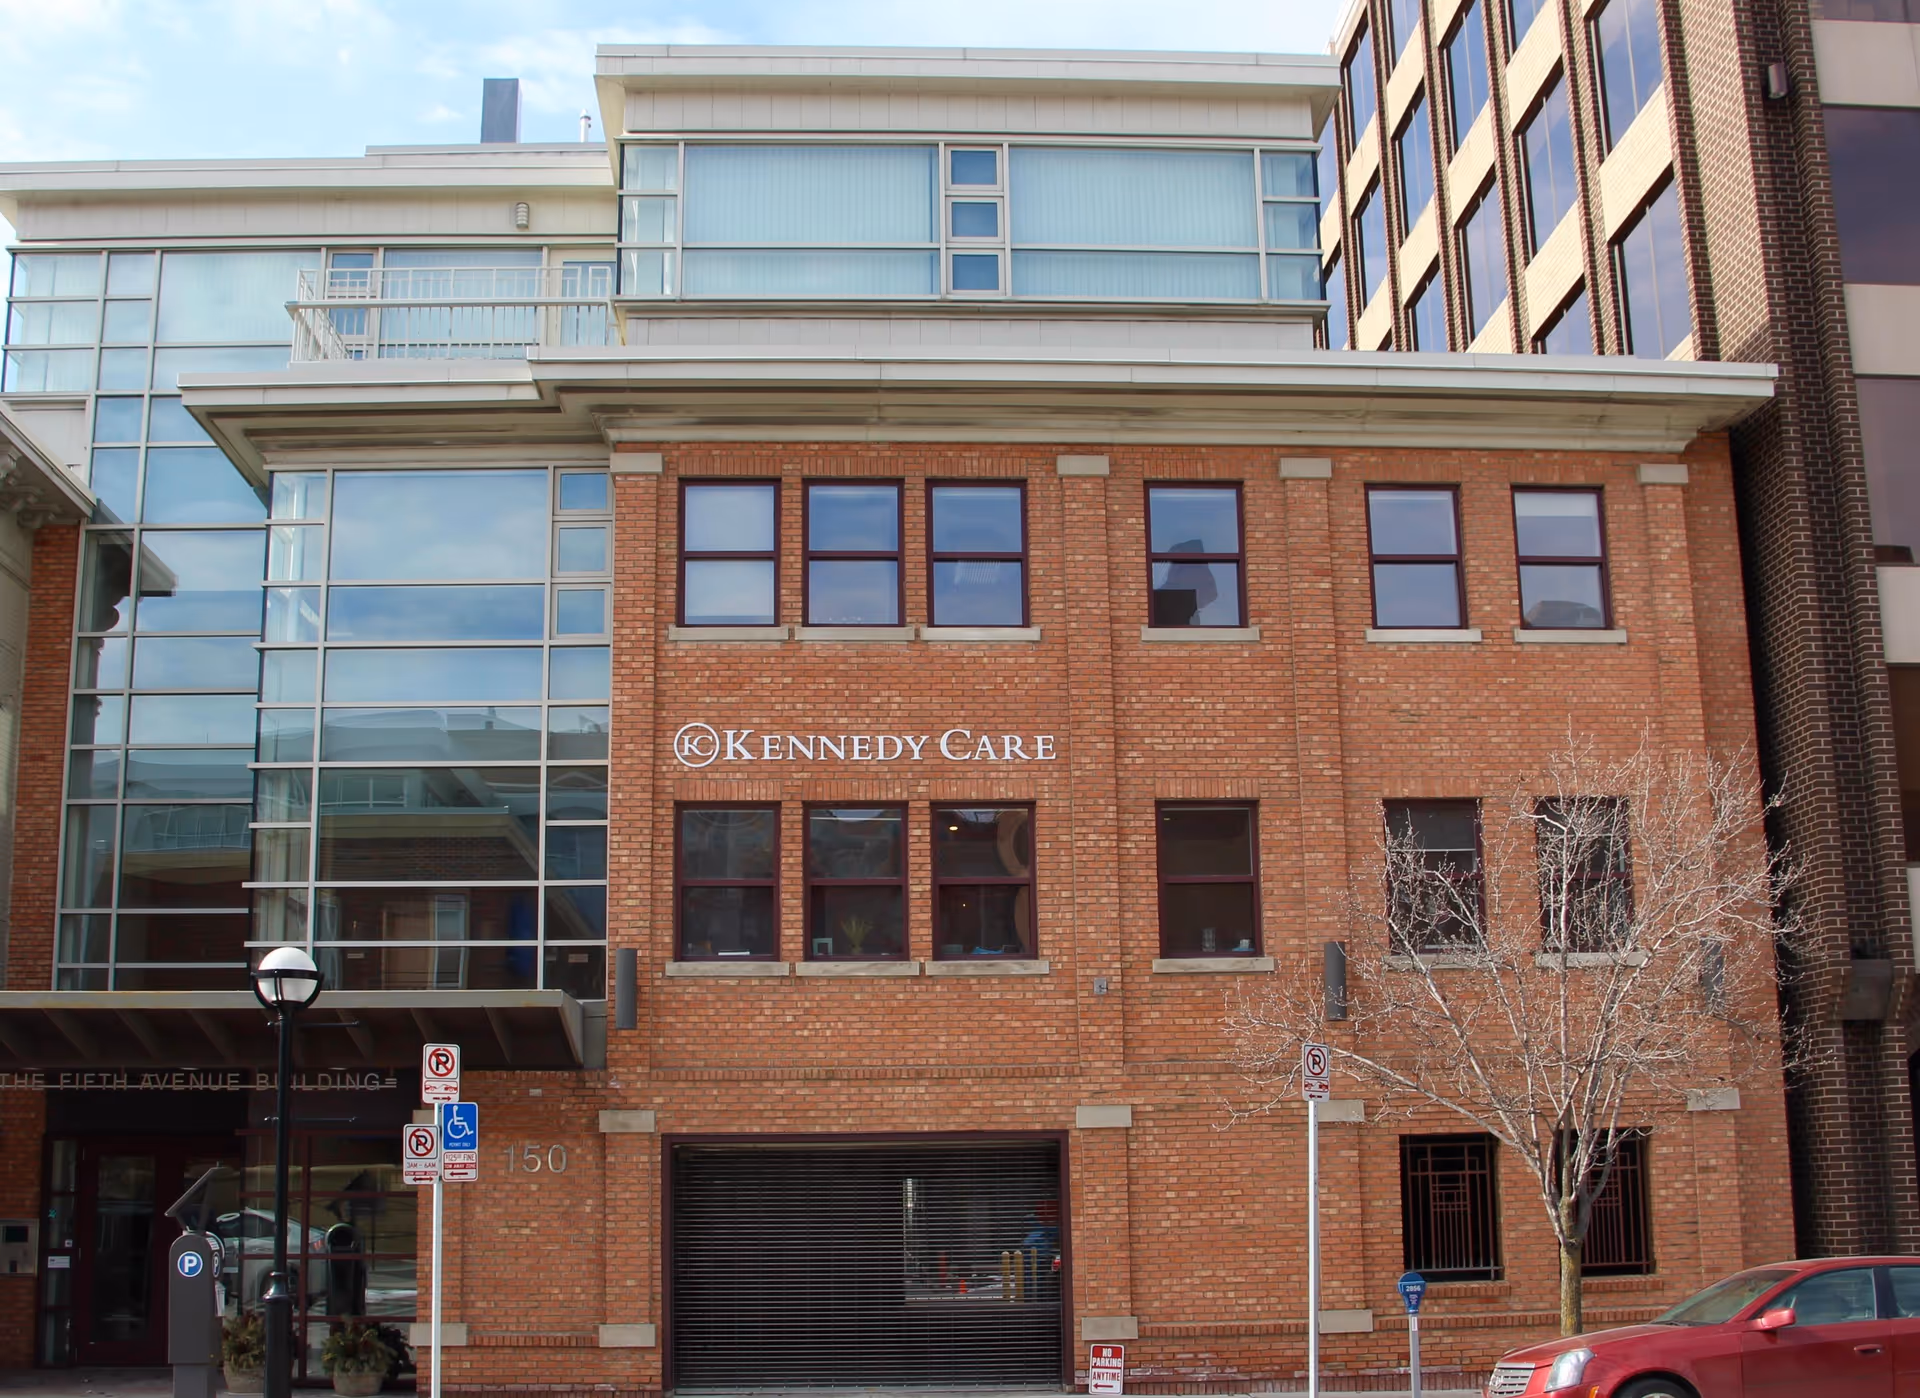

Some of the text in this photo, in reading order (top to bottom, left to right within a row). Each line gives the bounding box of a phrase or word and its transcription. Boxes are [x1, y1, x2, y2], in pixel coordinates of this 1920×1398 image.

[722, 729, 930, 760] KENNEDY
[939, 728, 1057, 761] CARE
[0, 1073, 45, 1091] THE
[60, 1073, 127, 1091] FIFTH
[139, 1073, 240, 1091] AVENUE
[463, 1153, 475, 1161] FINE
[503, 1144, 567, 1173] 150
[184, 1256, 198, 1273] P
[1102, 1348, 1112, 1357] NO
[1092, 1357, 1122, 1367] PARKING
[1092, 1371, 1121, 1381] ANYTIME
